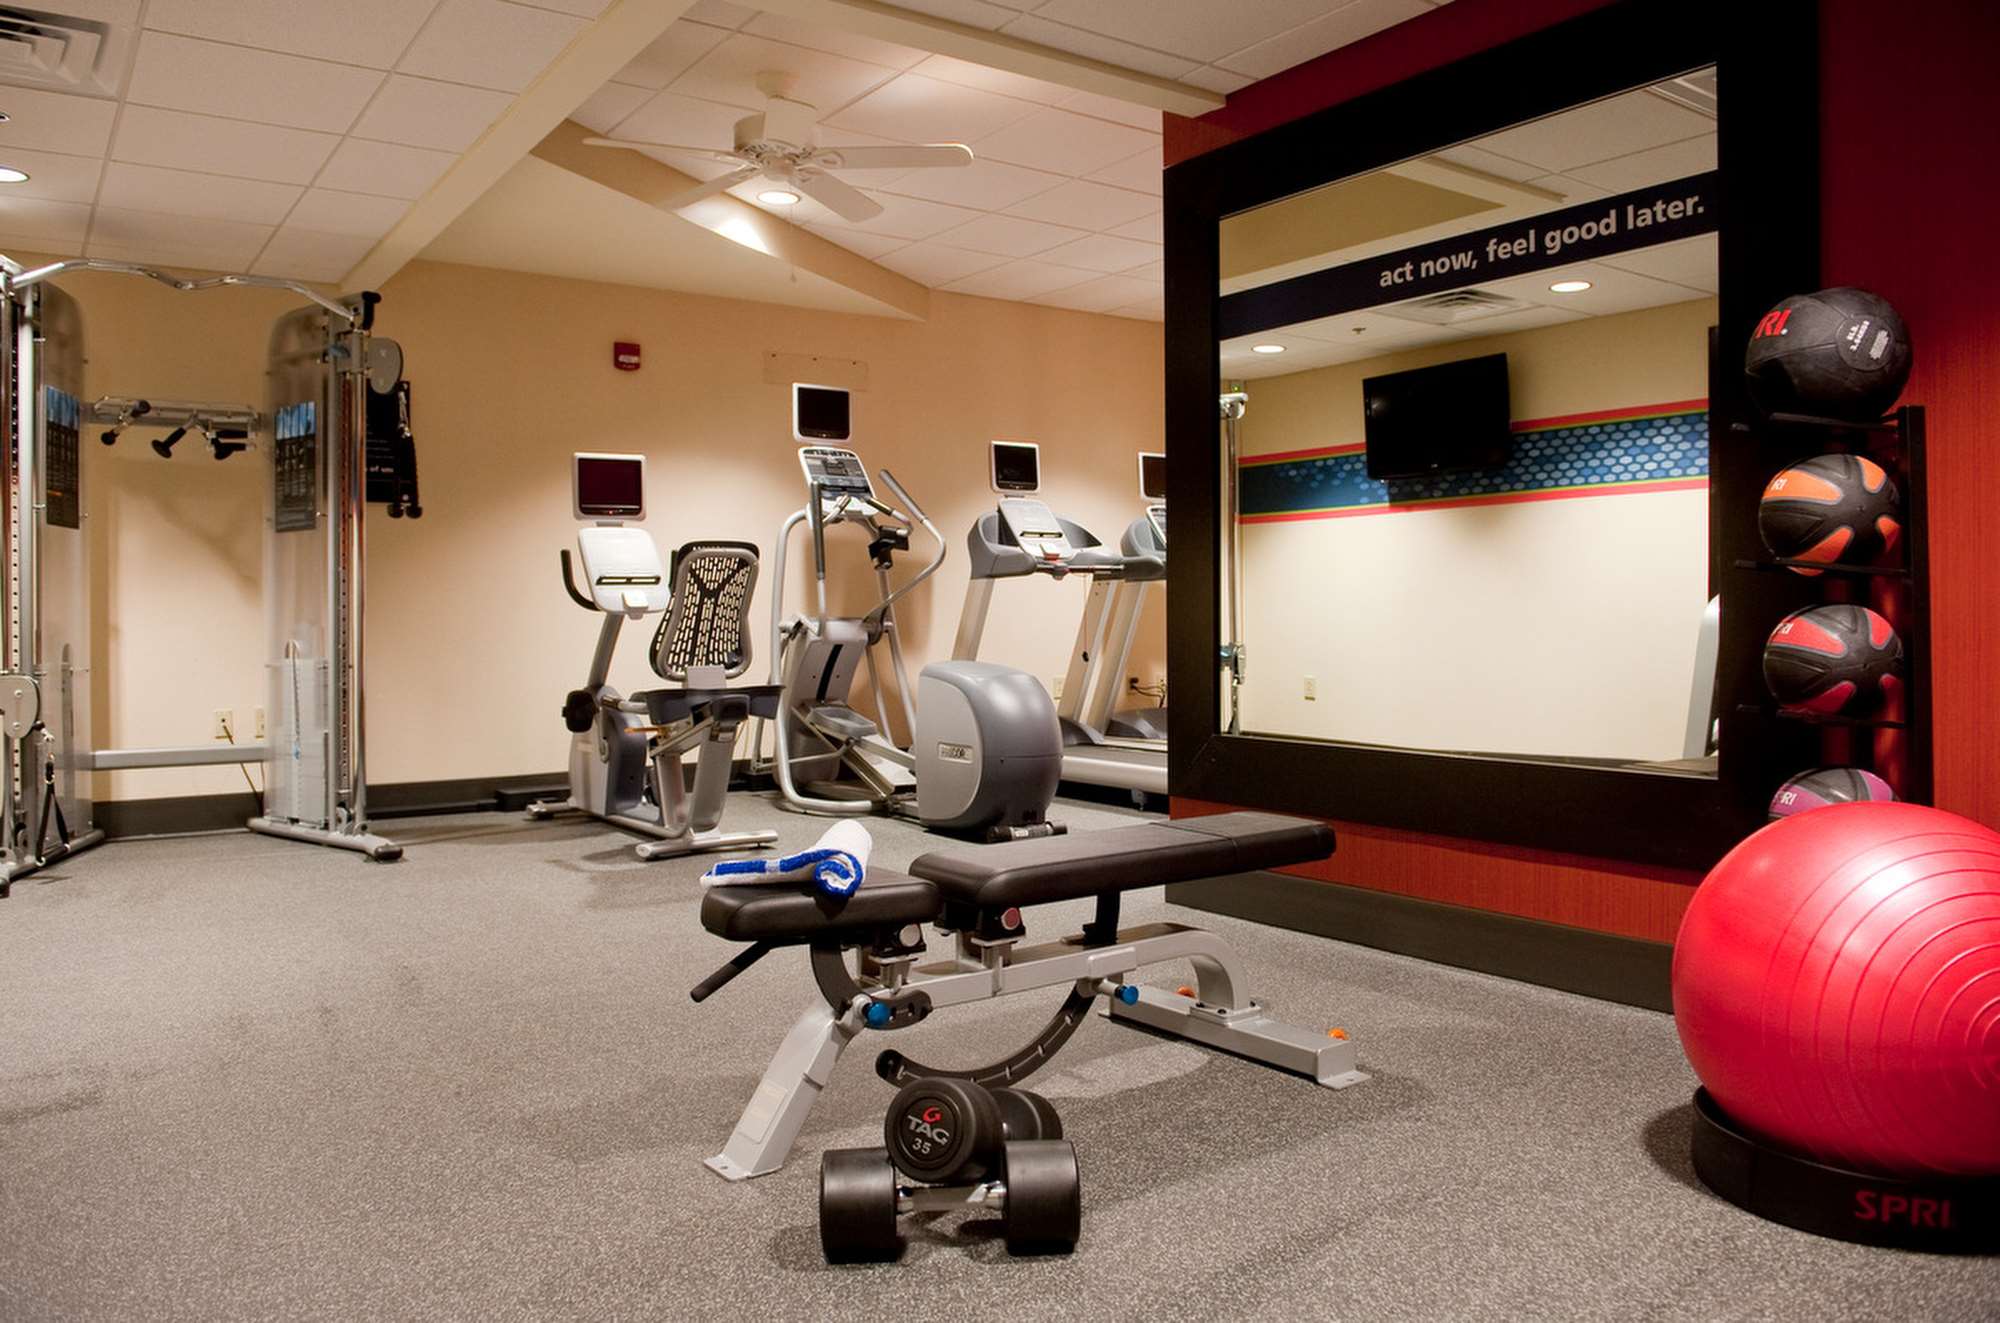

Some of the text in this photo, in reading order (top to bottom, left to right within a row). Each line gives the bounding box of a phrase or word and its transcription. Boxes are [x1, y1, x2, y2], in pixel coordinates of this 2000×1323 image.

[1379, 194, 1705, 288] act now, feel good later.
[1754, 307, 1792, 340] RI
[907, 1114, 950, 1146] TAG
[912, 1137, 932, 1154] 35
[1855, 1189, 1951, 1229] SPRI
